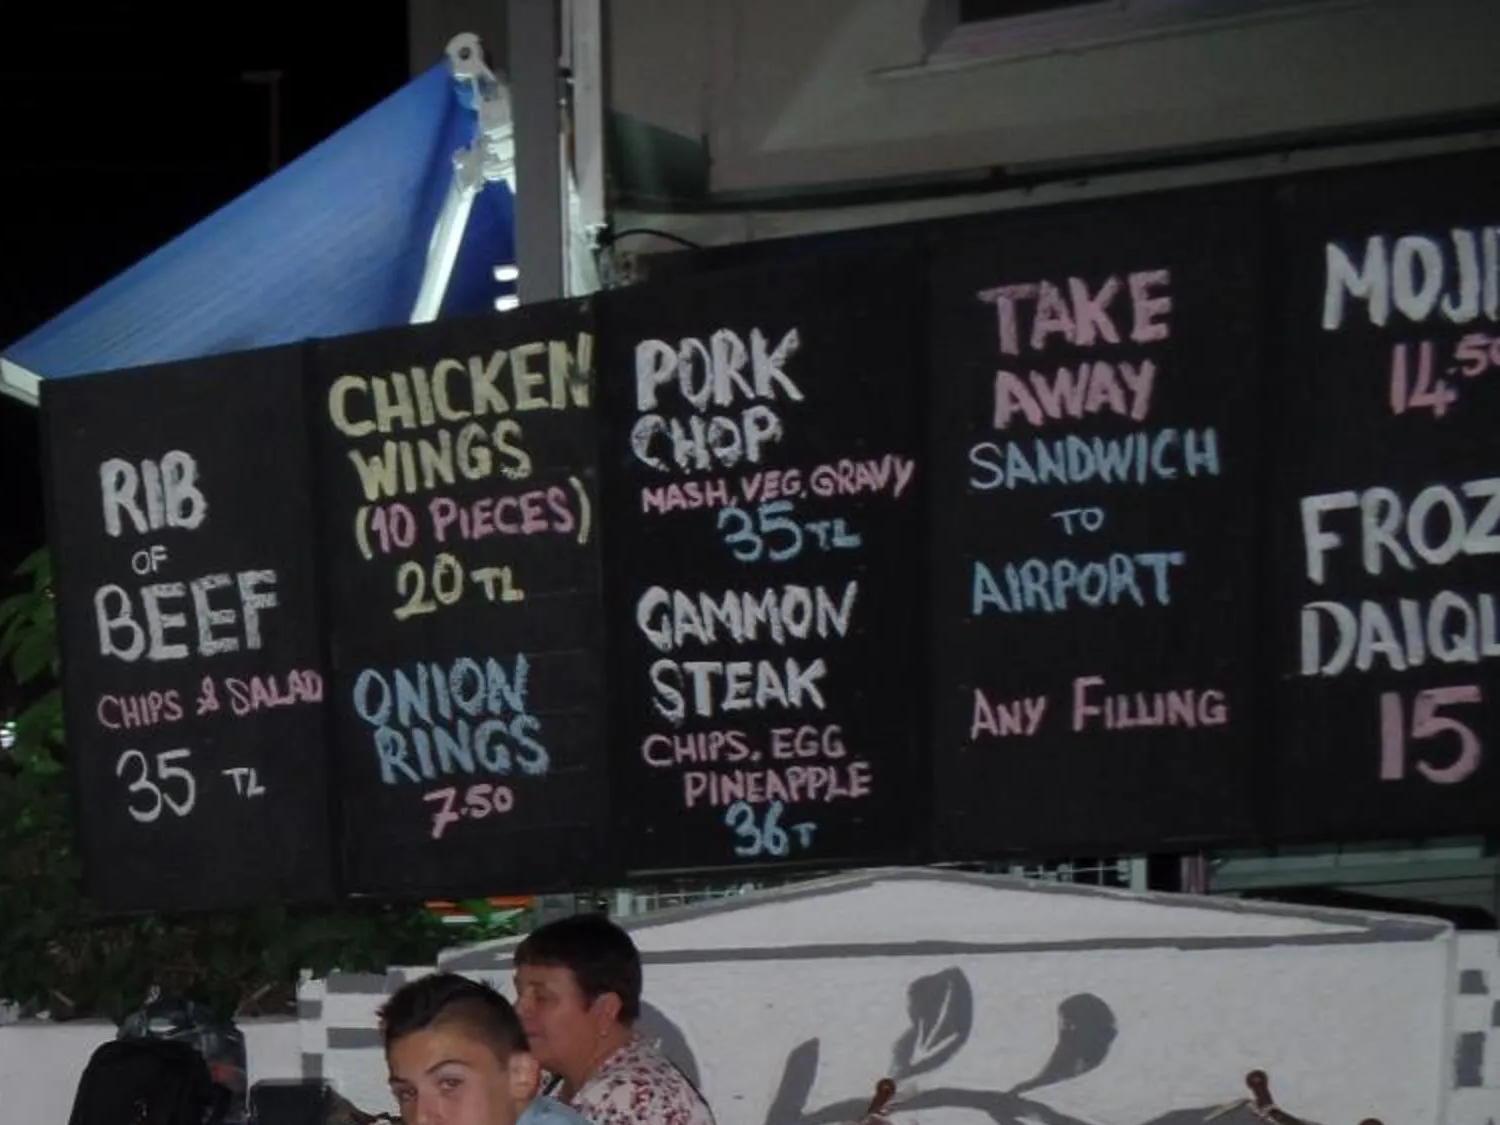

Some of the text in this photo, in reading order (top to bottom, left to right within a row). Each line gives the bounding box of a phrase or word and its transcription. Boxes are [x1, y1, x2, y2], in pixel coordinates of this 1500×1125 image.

[977, 269, 1173, 355] TAKE
[1321, 226, 1500, 331] MOJI
[328, 332, 595, 436] CHICKEN
[635, 327, 804, 411] PORK
[993, 358, 1156, 430] AWAY
[348, 420, 533, 500] WINGS
[630, 404, 783, 474] CHOP
[968, 427, 1220, 490] SANDWICH
[100, 449, 207, 538] RIB
[810, 452, 915, 500] GRAVY
[356, 476, 593, 560] (10 PIECES)
[716, 502, 862, 562] 35 TL
[1051, 507, 1105, 536] TO
[131, 545, 168, 575] OF
[393, 553, 525, 620] 20 TL
[971, 551, 1186, 615] AIRPORT
[93, 569, 278, 662] BEEF
[636, 580, 858, 650] GAMMON
[98, 669, 325, 730] CHIPS & SALAD
[353, 652, 532, 726] ONION
[648, 658, 827, 722] STEAK
[970, 688, 1046, 740] ANY
[373, 714, 550, 785] RINGS
[771, 724, 847, 760] EGG
[1379, 685, 1483, 784] 15
[116, 748, 266, 823] 35 TL
[423, 784, 514, 838] 7.50
[684, 760, 874, 808] PINEAPPLE
[725, 800, 790, 856] 36
